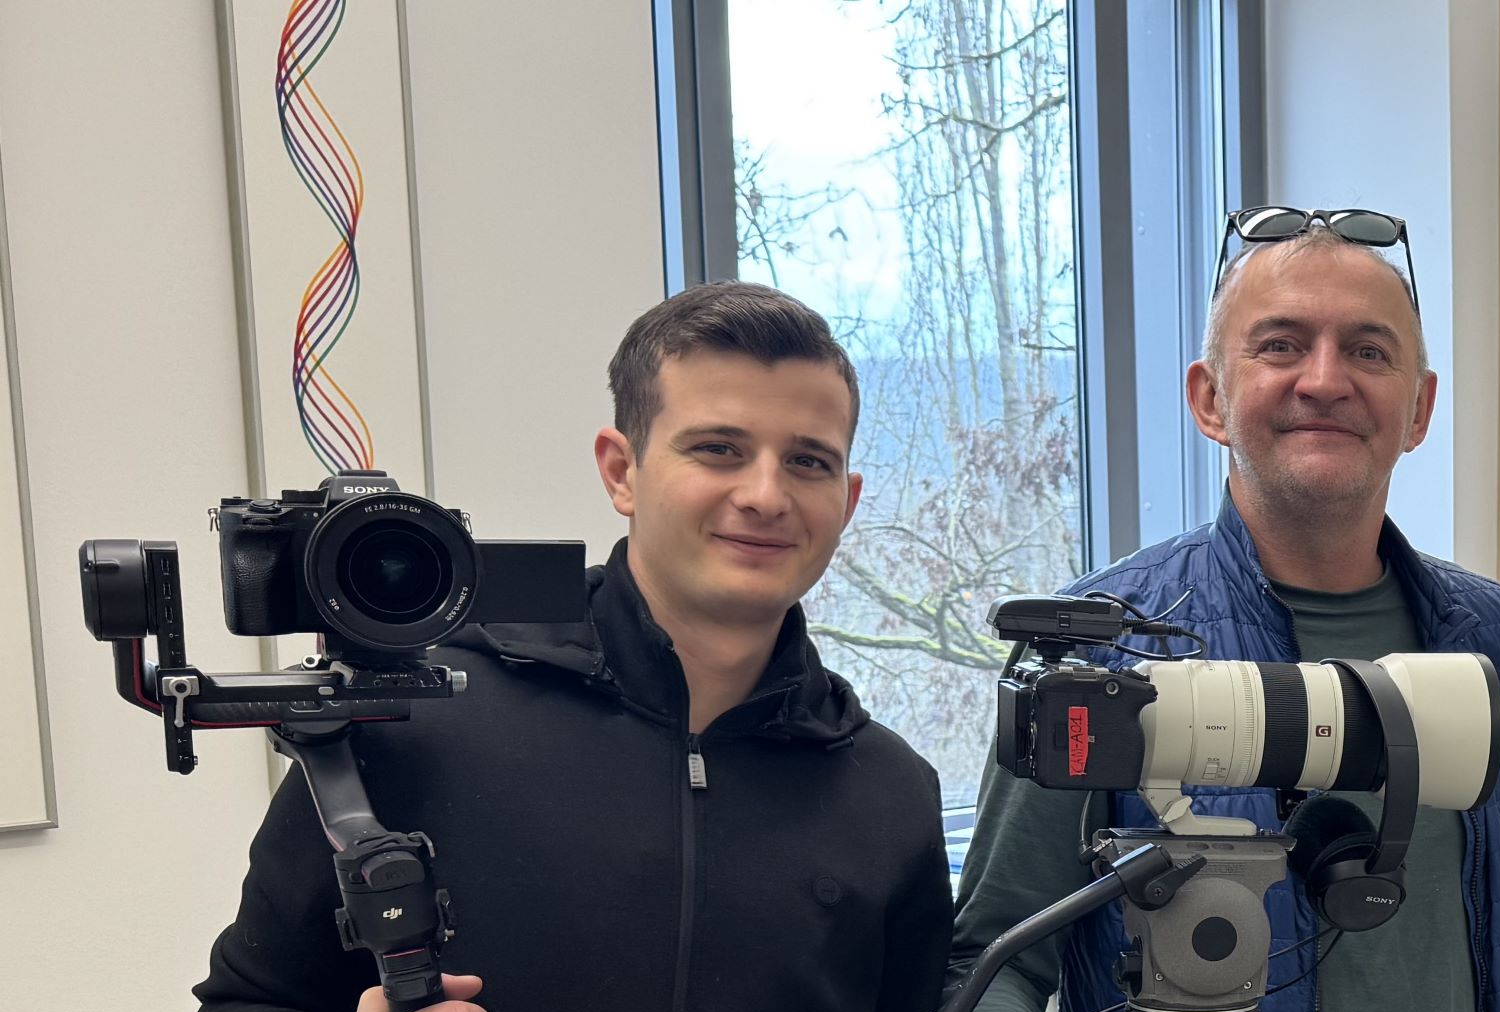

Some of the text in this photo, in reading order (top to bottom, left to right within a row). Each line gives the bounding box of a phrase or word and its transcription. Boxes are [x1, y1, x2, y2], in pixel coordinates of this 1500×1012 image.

[343, 486, 389, 494] SONY
[1365, 896, 1395, 905] SONY
[382, 907, 403, 920] dji
